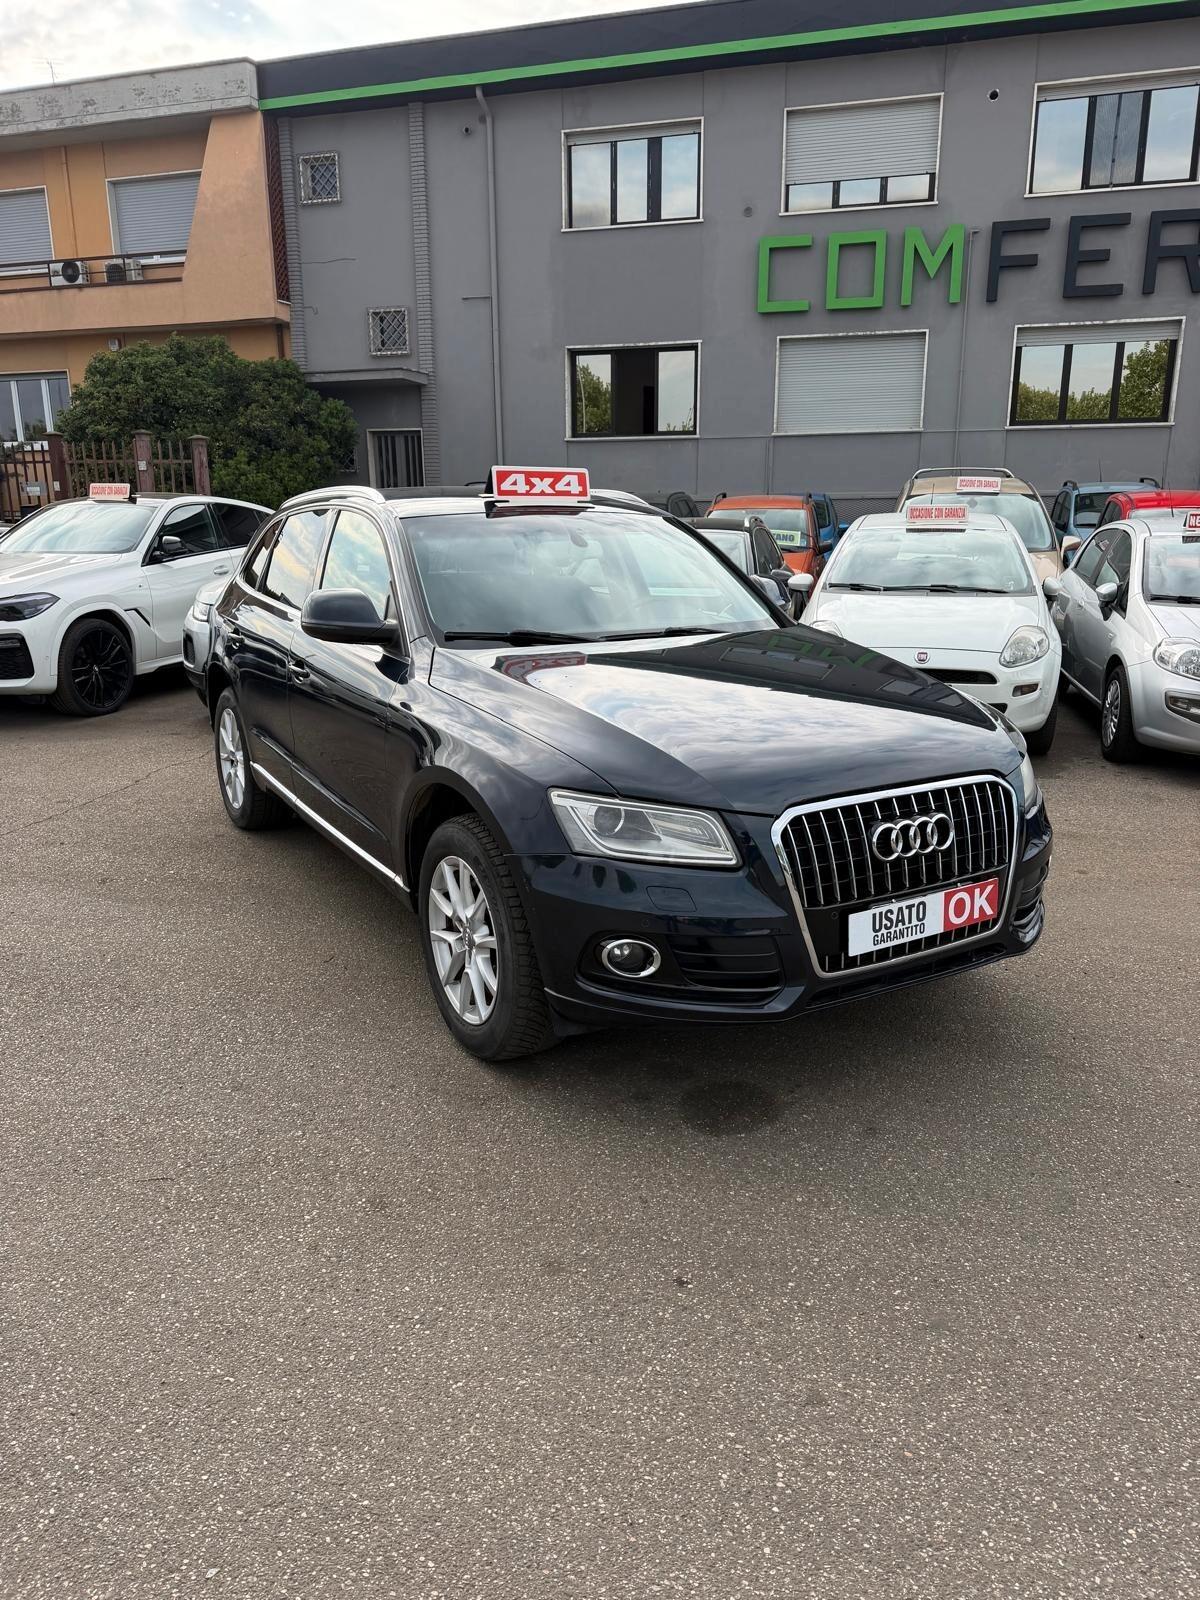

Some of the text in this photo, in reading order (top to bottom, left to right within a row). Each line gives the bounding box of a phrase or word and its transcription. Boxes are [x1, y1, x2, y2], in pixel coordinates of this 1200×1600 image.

[500, 473, 582, 494] 4x4
[910, 507, 933, 519] OCCASIONE
[872, 900, 927, 934] USATO
[948, 884, 995, 925] OK
[872, 922, 926, 947] GARANTITO
